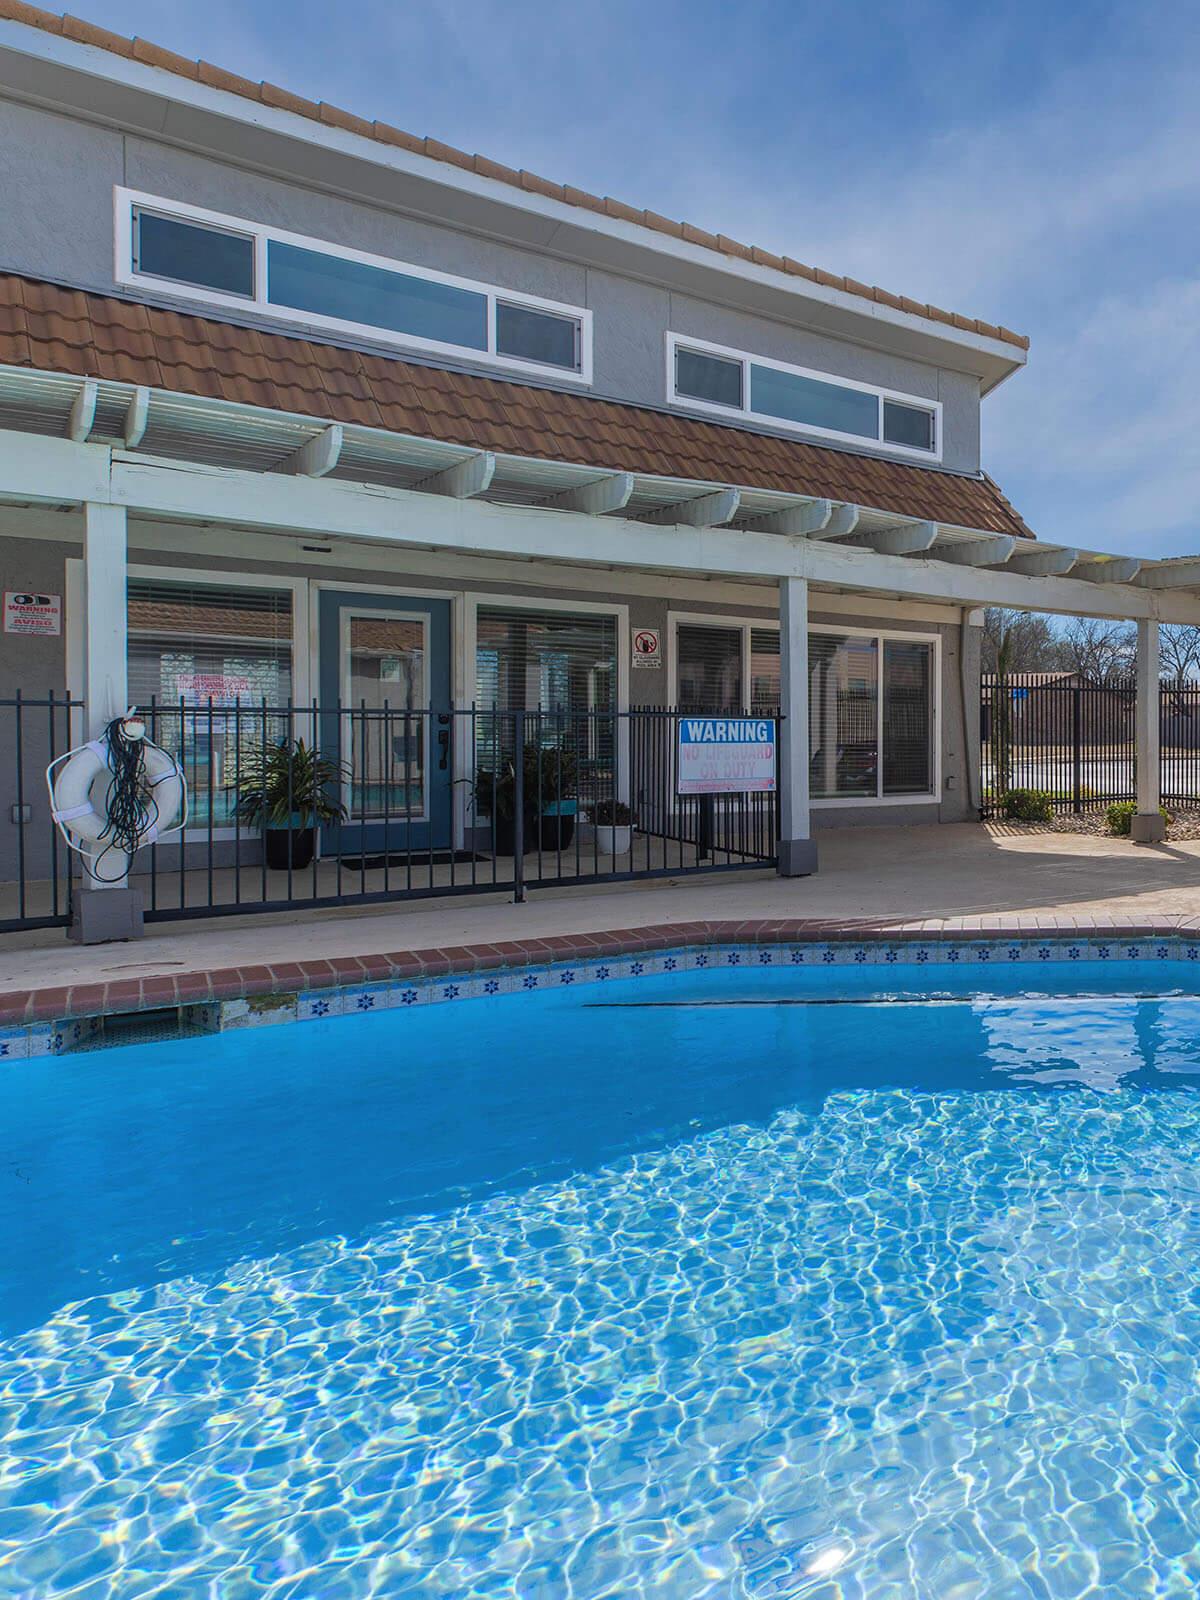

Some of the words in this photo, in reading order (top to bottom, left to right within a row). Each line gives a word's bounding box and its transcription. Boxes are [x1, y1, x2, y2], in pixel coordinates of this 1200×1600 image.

[8, 605, 58, 613] WARNING
[687, 722, 768, 741] WARNING
[683, 744, 699, 761] NO
[701, 762, 718, 779] ON
[724, 761, 756, 778] DUTY
